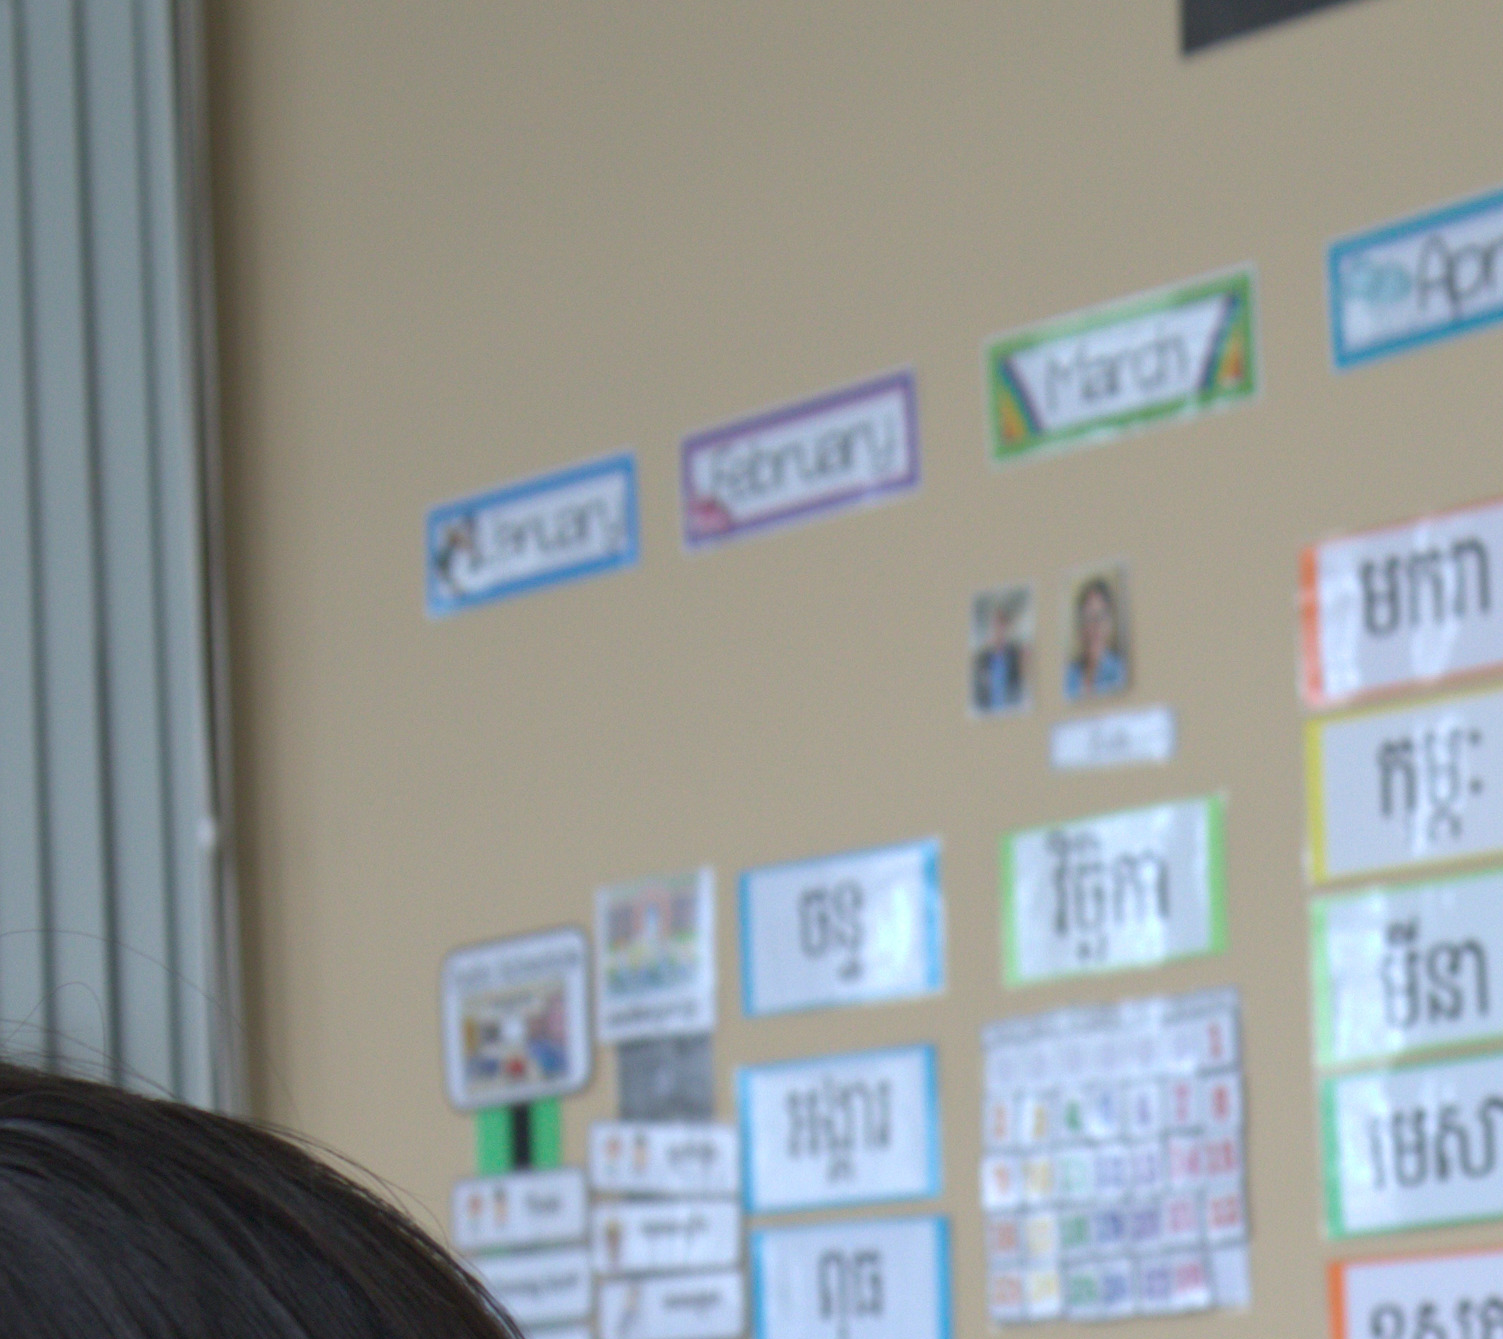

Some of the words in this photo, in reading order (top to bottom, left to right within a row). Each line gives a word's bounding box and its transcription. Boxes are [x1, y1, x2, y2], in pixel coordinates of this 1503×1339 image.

[1043, 324, 1191, 414] March
[709, 413, 898, 503] February
[1360, 535, 1491, 639] មករា
[1380, 916, 1491, 1031] មីនា
